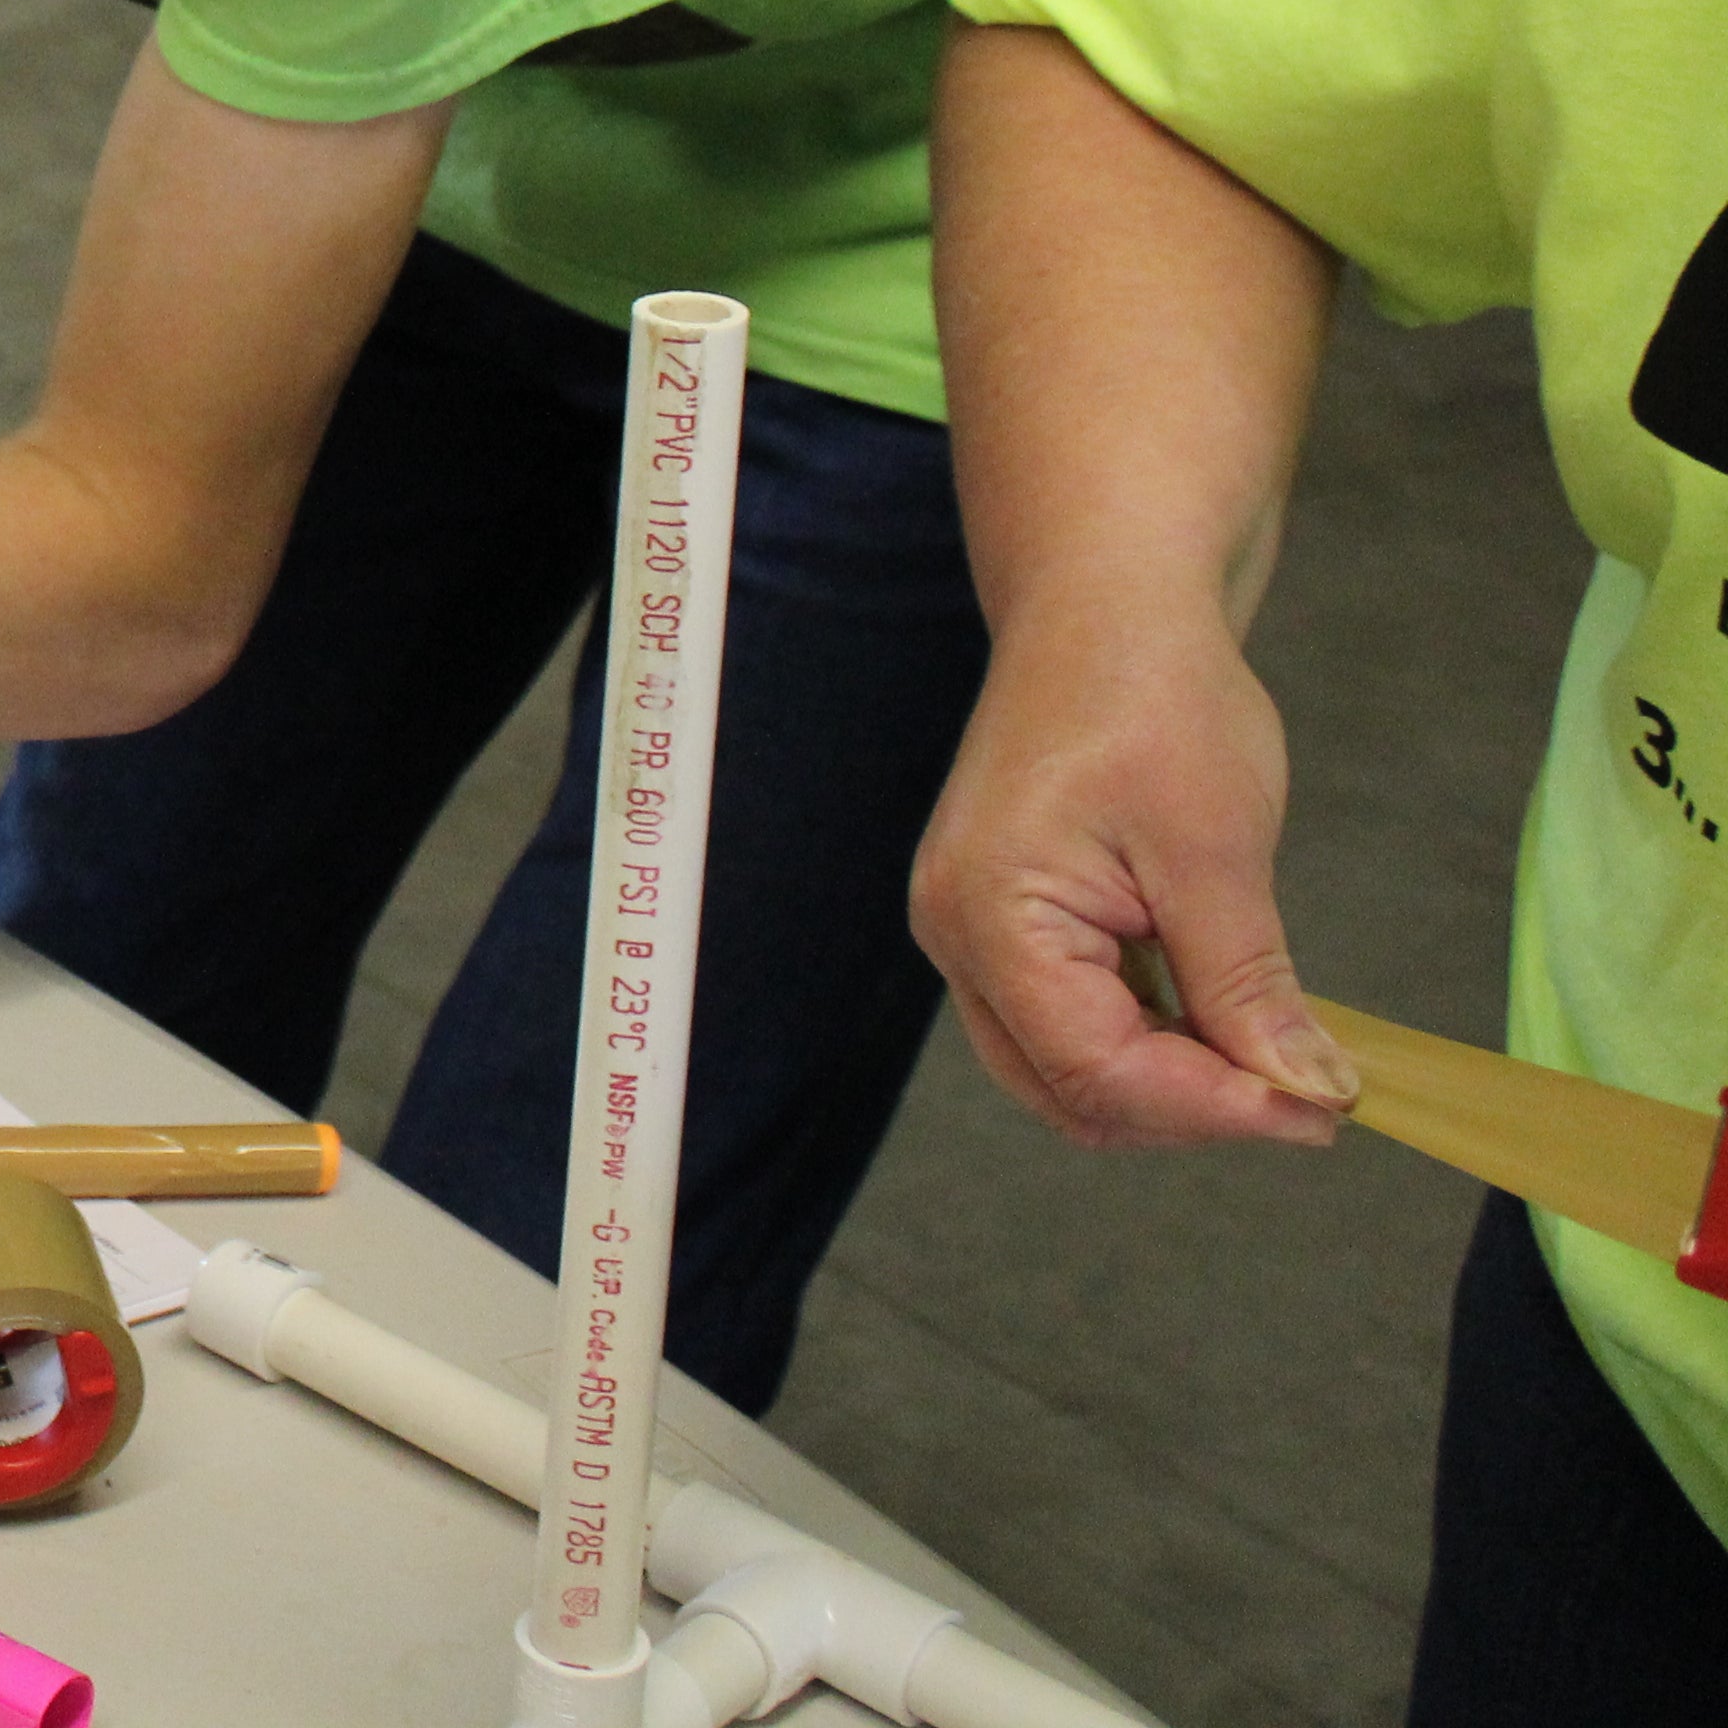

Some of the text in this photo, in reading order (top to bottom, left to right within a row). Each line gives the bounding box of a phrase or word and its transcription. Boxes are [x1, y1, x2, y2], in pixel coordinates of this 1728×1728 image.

[645, 498, 690, 575] 1120
[639, 593, 683, 654] SCH
[635, 673, 674, 710] 40
[630, 730, 673, 770] PR
[625, 788, 667, 847] 600
[616, 865, 661, 919] PSI
[614, 940, 654, 960] @
[576, 1365, 619, 1447] ASTM
[572, 1461, 611, 1482] D
[565, 1499, 607, 1567] 1785
